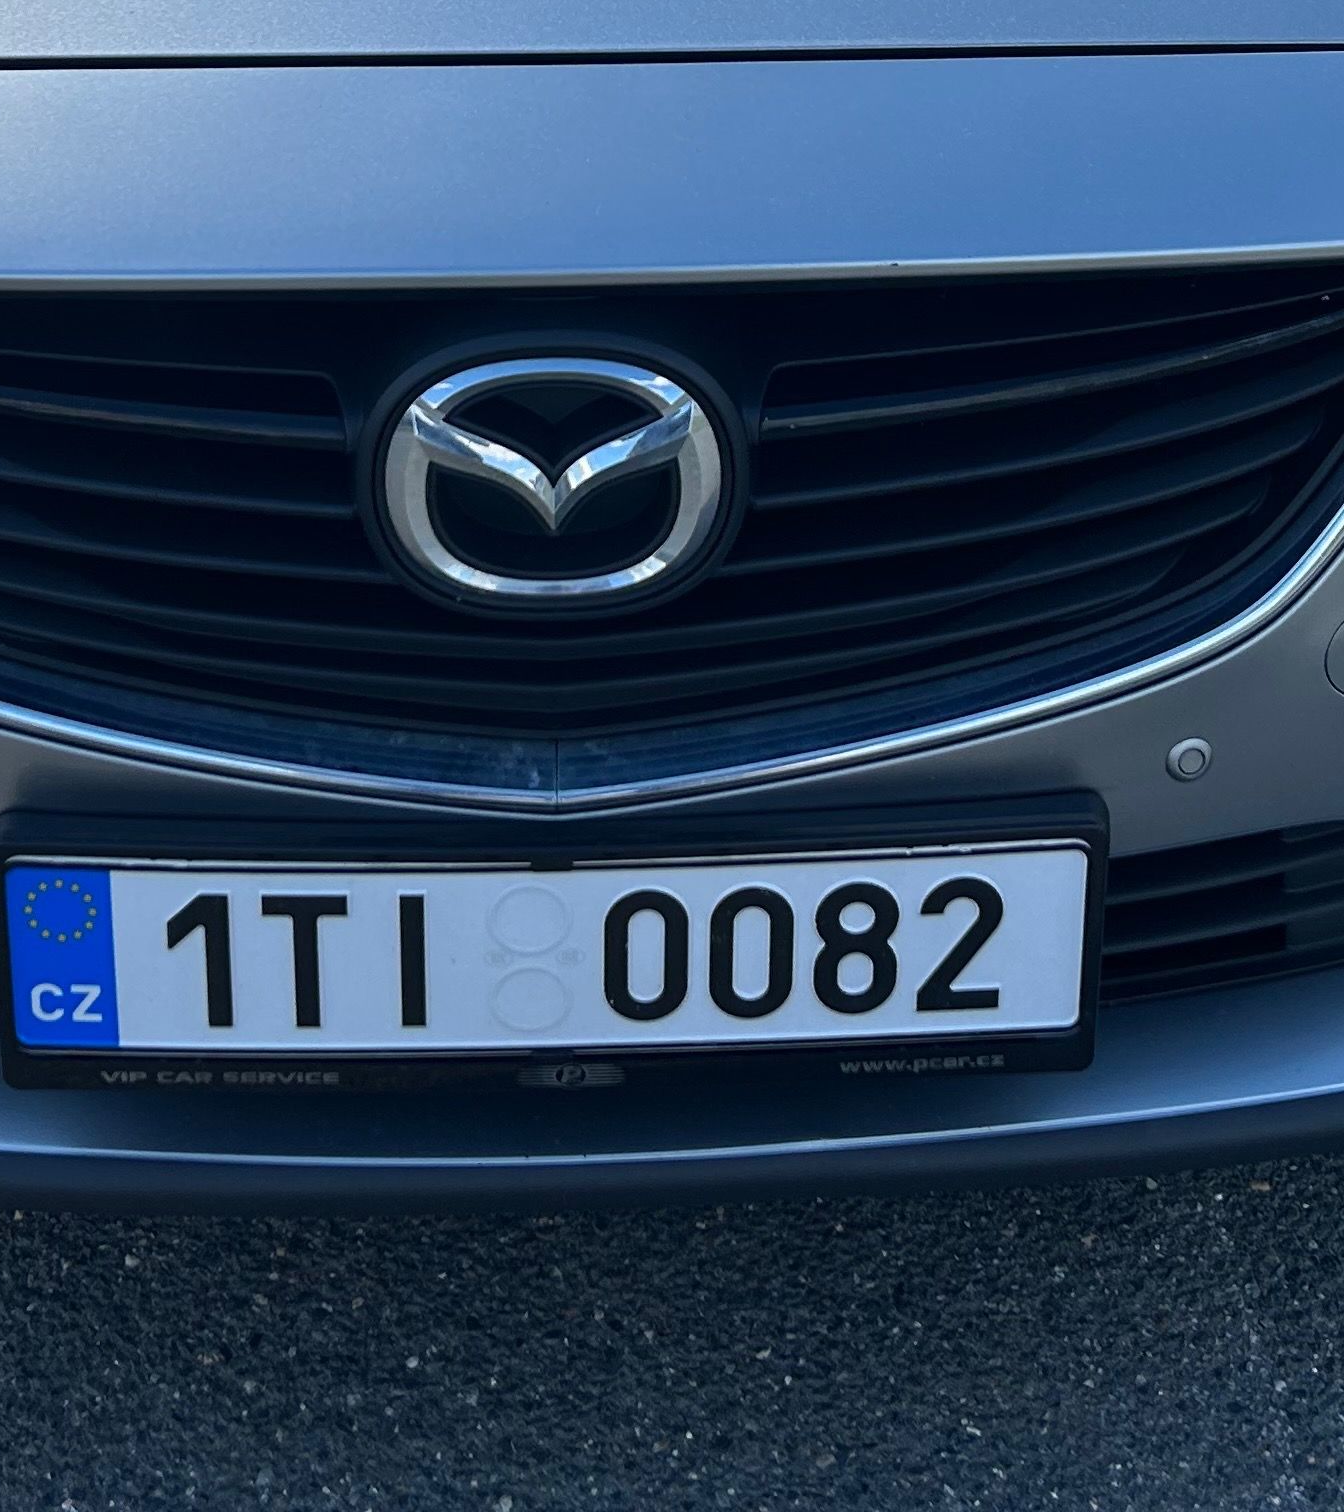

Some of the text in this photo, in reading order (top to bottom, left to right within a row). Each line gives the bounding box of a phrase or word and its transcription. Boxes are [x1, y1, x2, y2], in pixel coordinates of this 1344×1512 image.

[166, 876, 1005, 1029] 1TI 0082
[30, 984, 103, 1022] CZ
[101, 1070, 340, 1086] VIP CAR SERVICE
[839, 1054, 1005, 1074] www.pcar.cz
